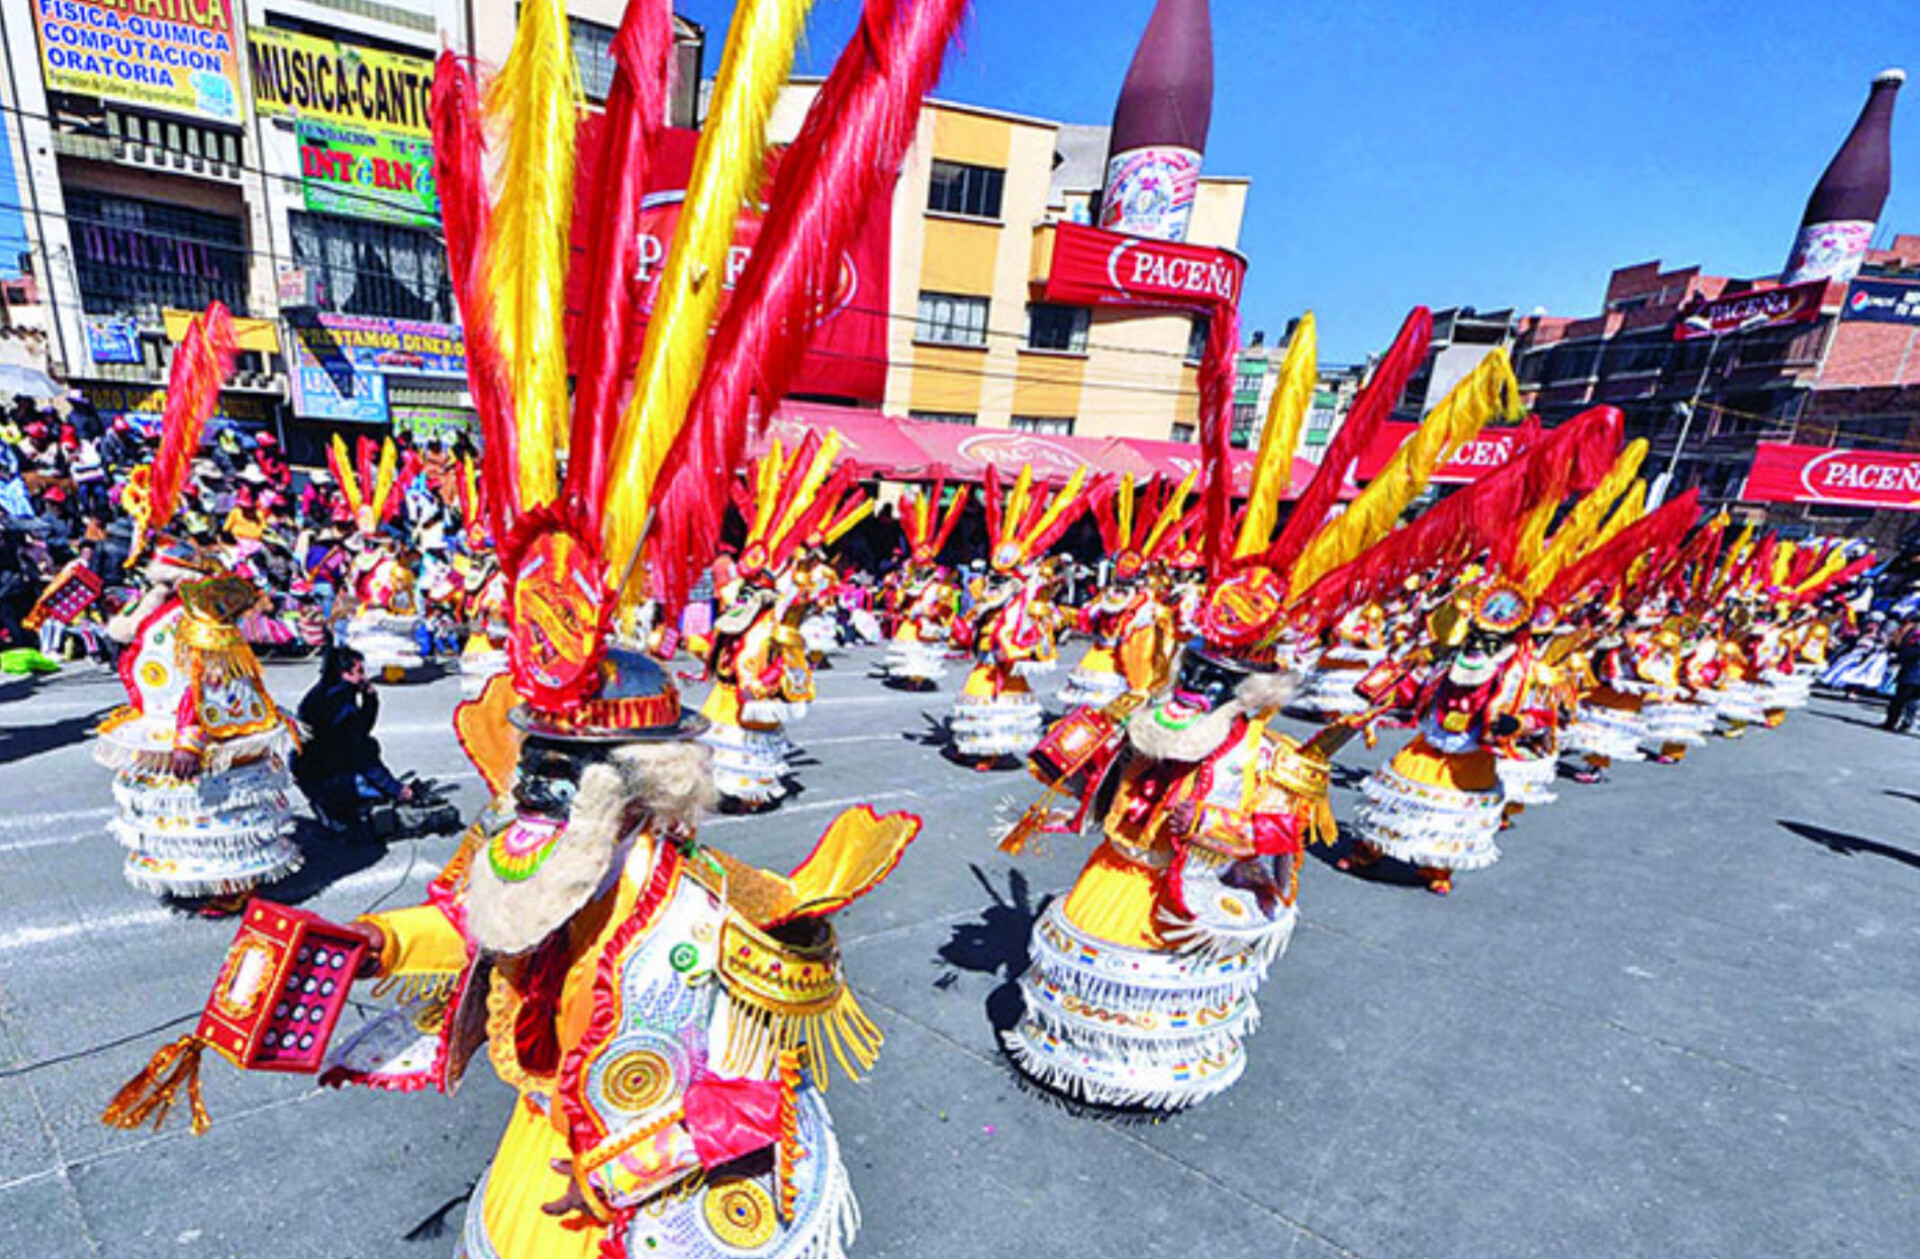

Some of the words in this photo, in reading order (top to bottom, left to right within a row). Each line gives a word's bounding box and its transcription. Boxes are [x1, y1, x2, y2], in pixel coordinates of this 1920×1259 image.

[43, 22, 221, 72] COMPUTACION
[47, 47, 174, 87] ORATORIA
[1130, 252, 1233, 299] PACEÑA
[1822, 461, 1920, 492] PACEÑ
